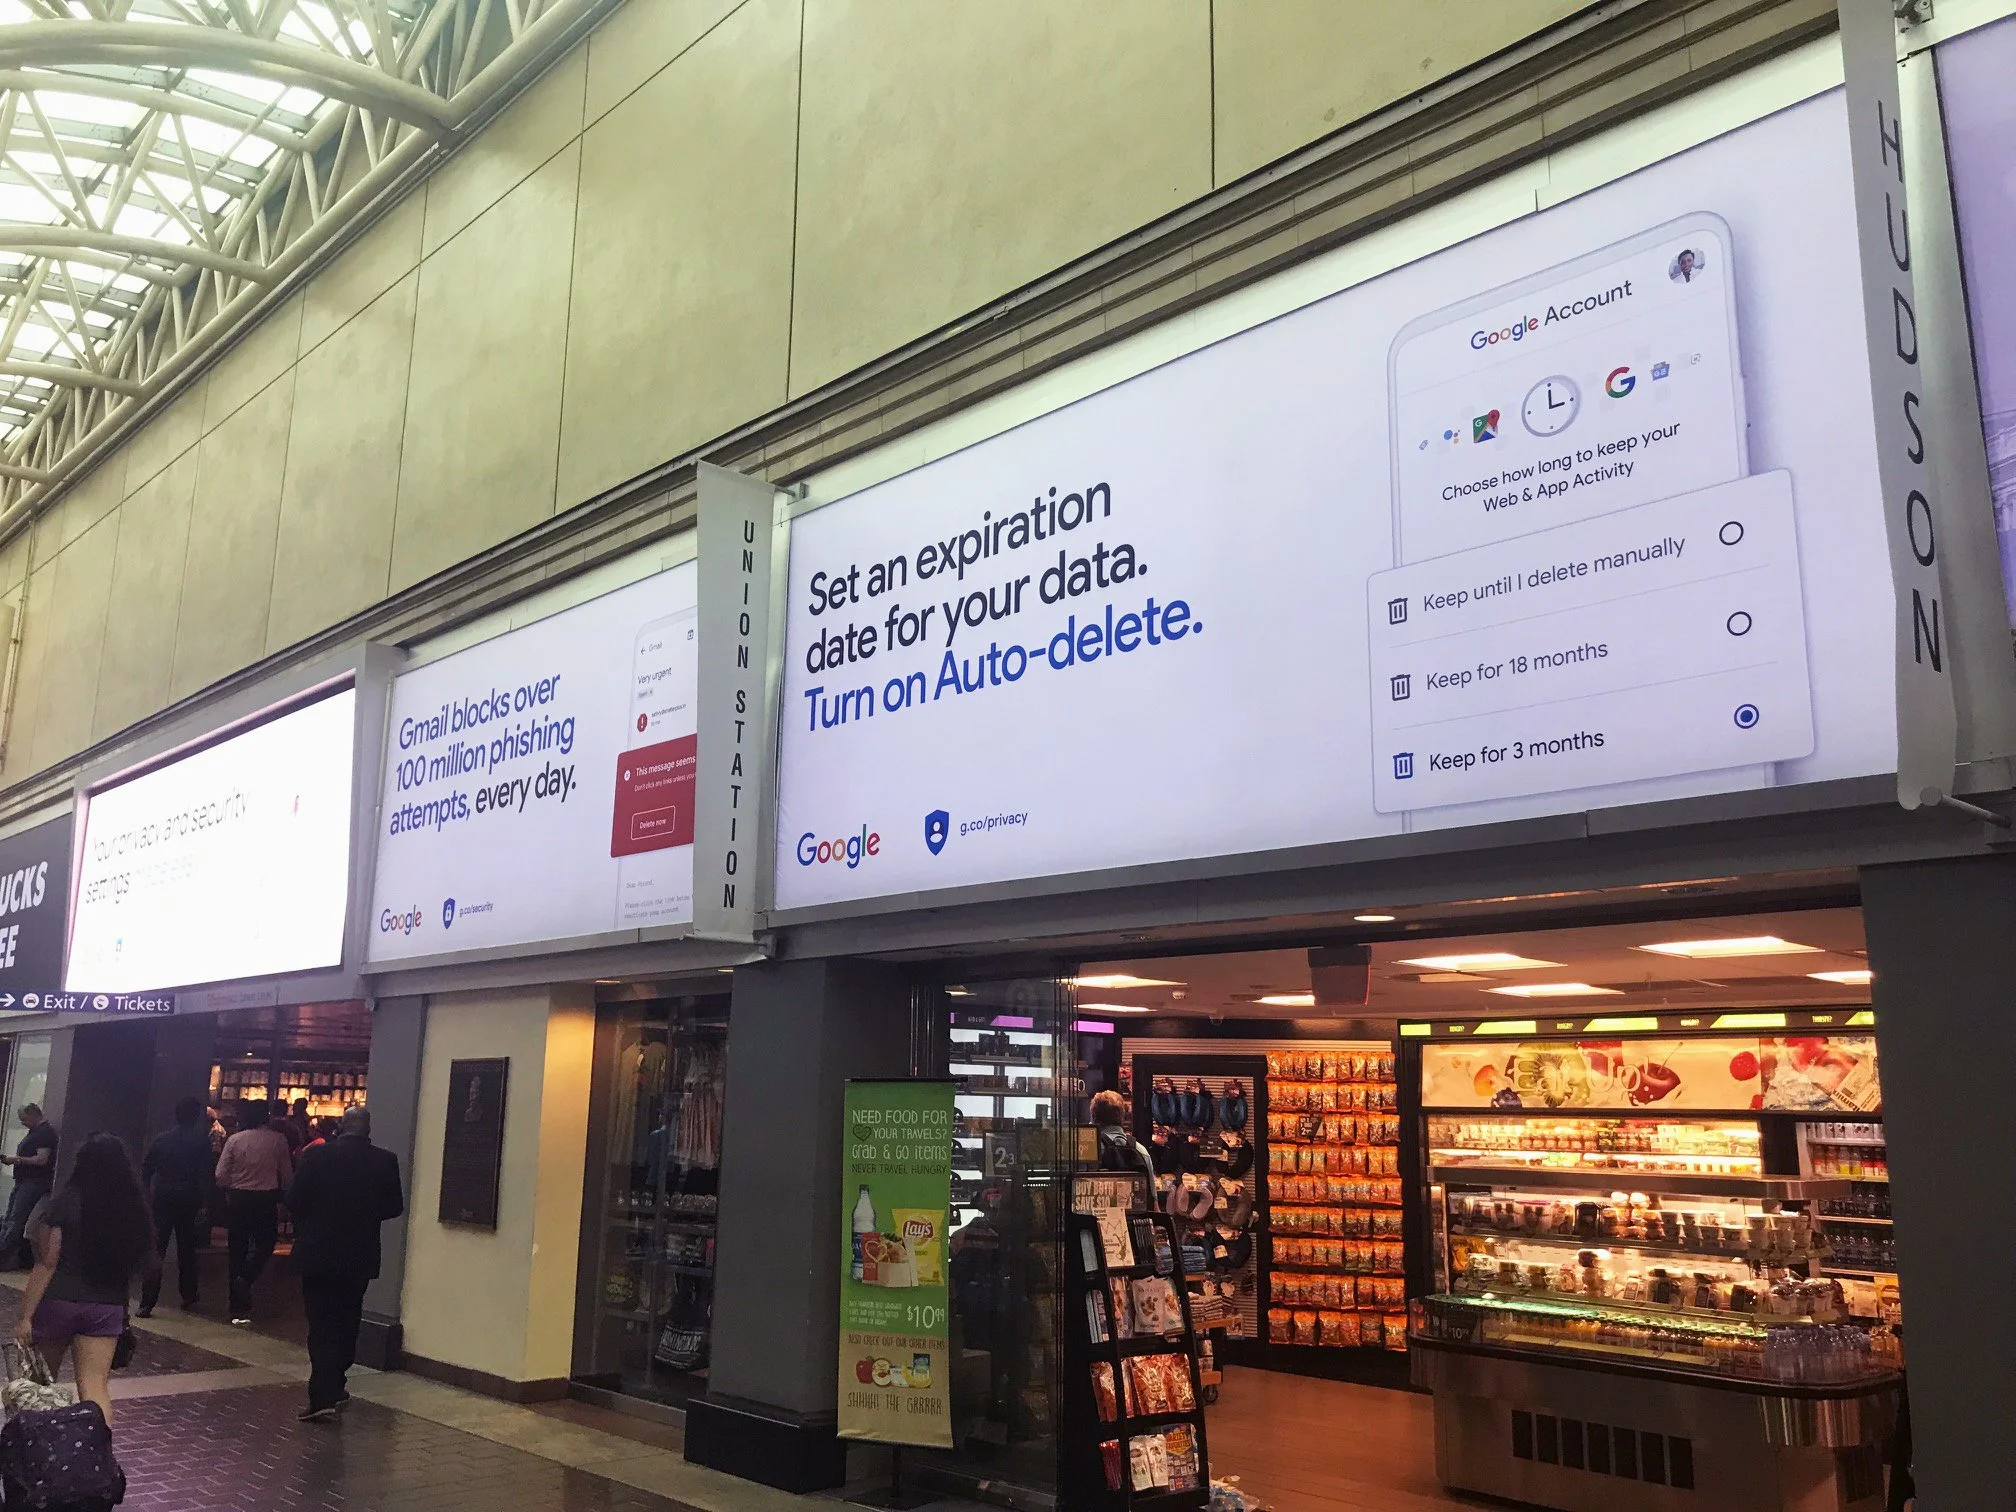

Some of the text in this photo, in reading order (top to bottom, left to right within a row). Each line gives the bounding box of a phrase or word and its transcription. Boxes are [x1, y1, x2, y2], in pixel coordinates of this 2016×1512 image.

[1470, 279, 1633, 350] Google Account
[1878, 100, 1942, 673] HUDSON
[1442, 422, 1682, 500] Choose how long to keep your
[1483, 460, 1635, 513] Web & App Activity
[807, 481, 1112, 617] Set an expiration
[1423, 537, 1686, 613] Keep until I delete manually
[806, 542, 1148, 674] date for your data.
[637, 667, 672, 685] Very urgent
[804, 597, 1203, 732] Turn on Auto-delete.
[1426, 641, 1609, 692] Keep for 18 months
[399, 673, 561, 750] Gmail blocks over
[723, 519, 755, 909] UNION STATION
[396, 715, 576, 792] 100 million phishing
[636, 755, 696, 776] This message seems
[1429, 729, 1605, 774] Keep for 3 months
[390, 761, 577, 835] attempts, every day.
[960, 809, 1028, 836] g.co/privacy
[797, 823, 880, 869] Google
[380, 904, 422, 934] Google
[44, 994, 75, 1010] Exit
[115, 996, 170, 1012] Tickets
[852, 1109, 947, 1124] NEED FOOD FOR
[873, 1127, 947, 1140] YOUR TRAVELS?
[851, 1163, 947, 1175] NEVER TRAVEL HUNGRY
[883, 1144, 891, 1160] &
[1075, 1181, 1114, 1196] BUY BOTH
[1075, 1195, 1095, 1211] SAVE
[885, 1394, 900, 1413] THE
